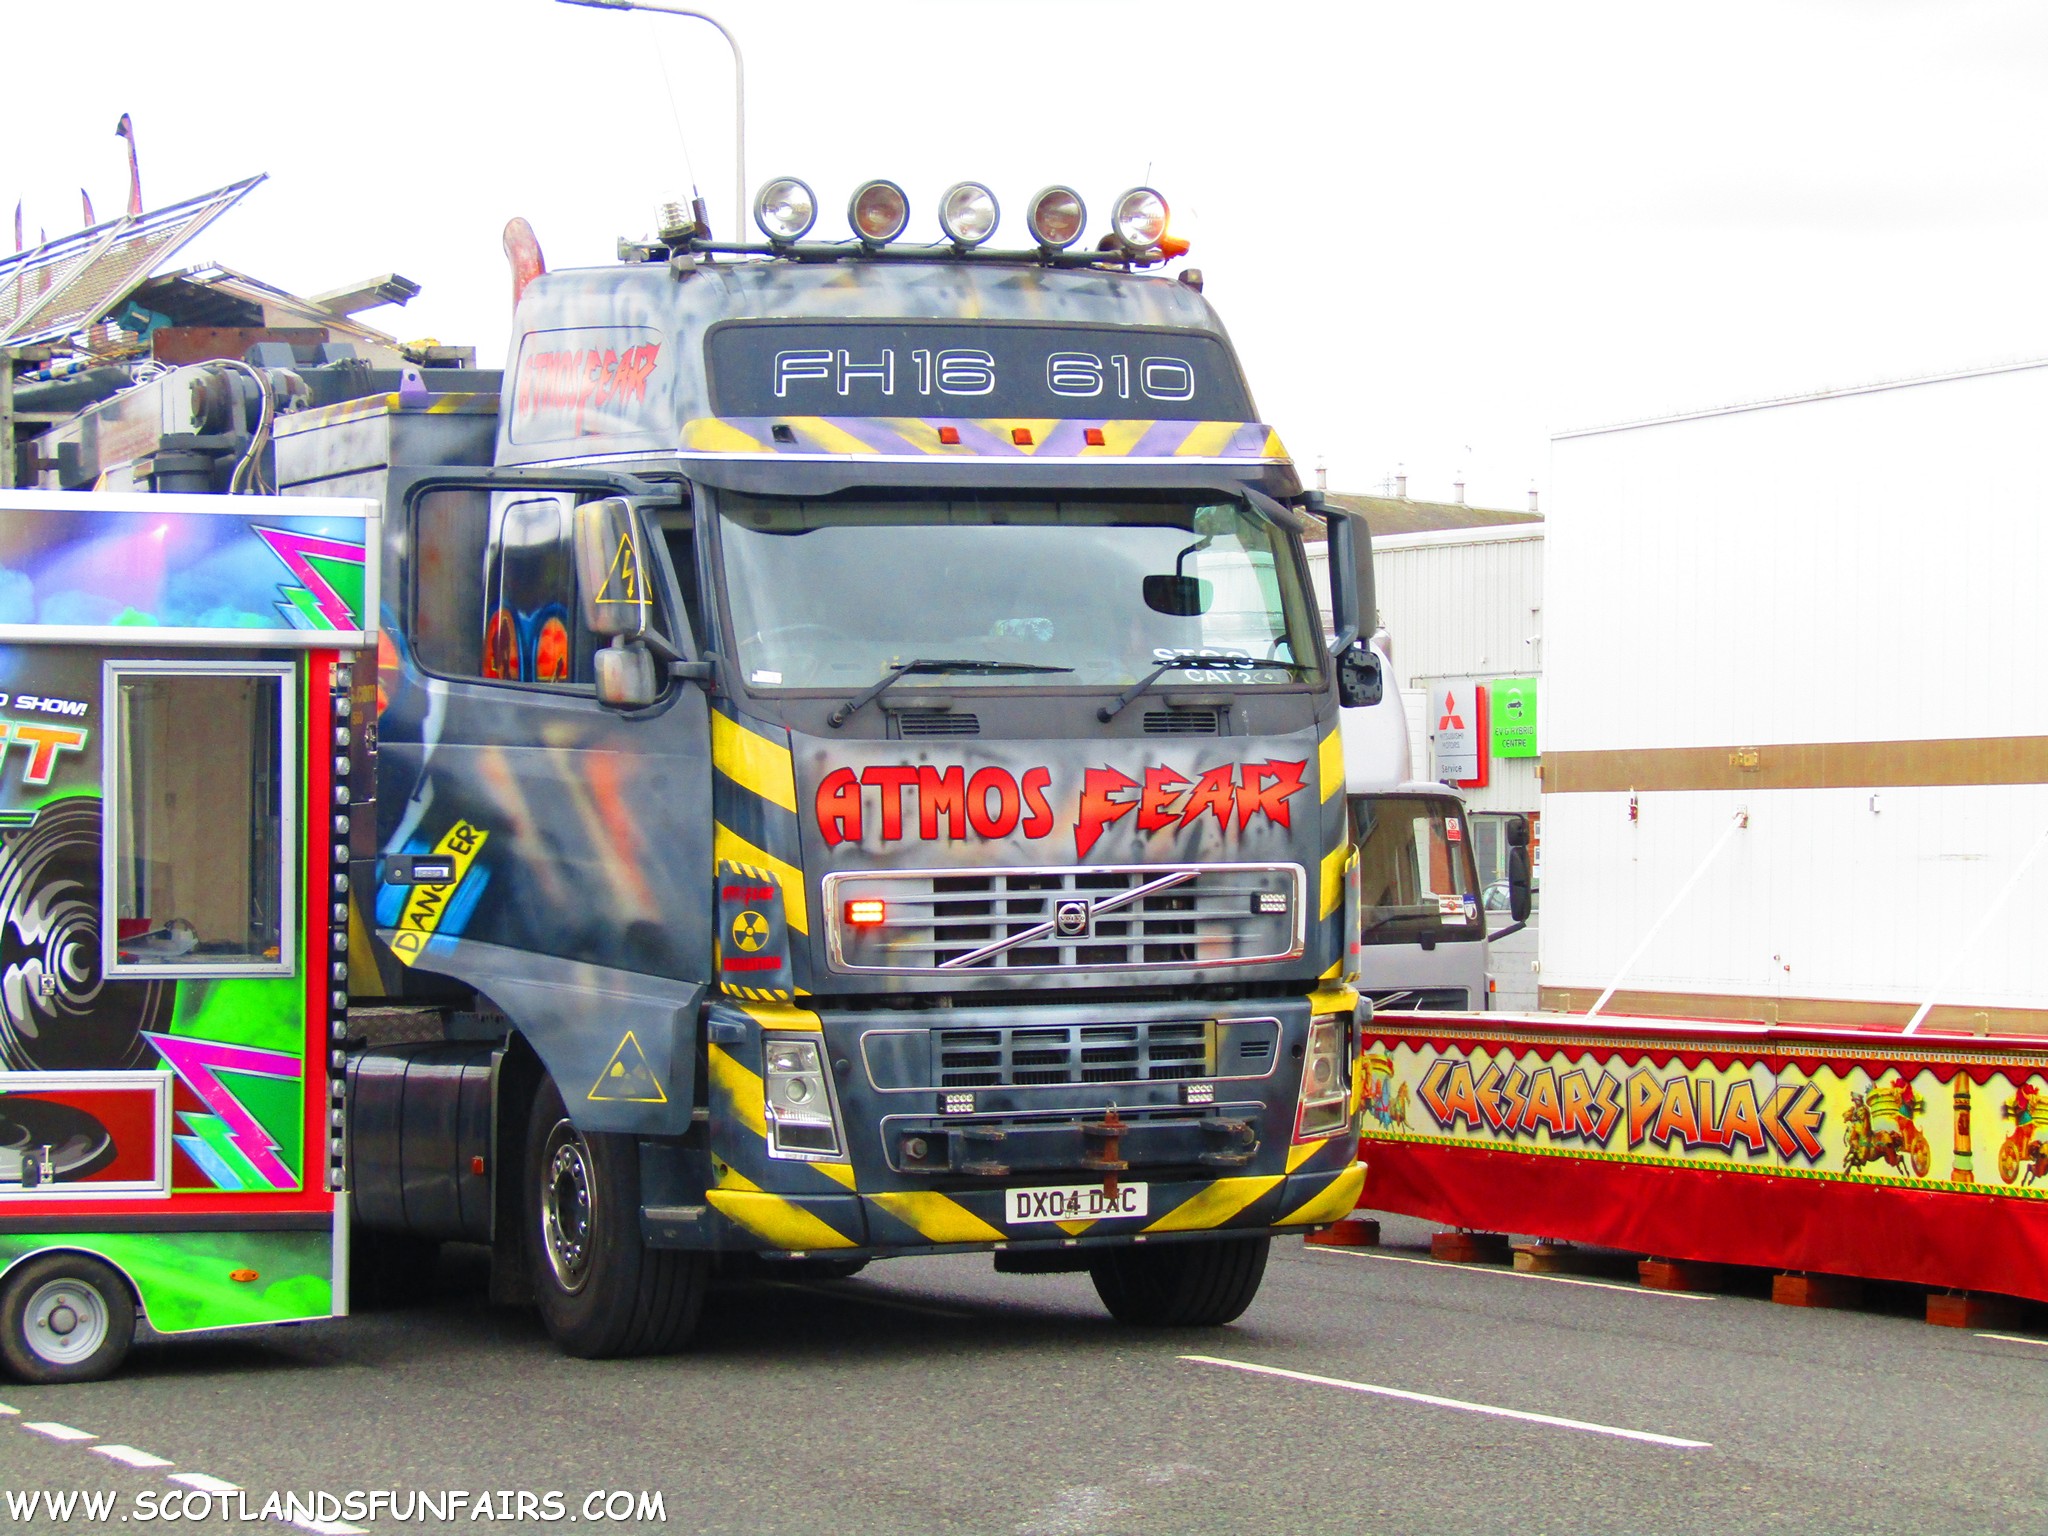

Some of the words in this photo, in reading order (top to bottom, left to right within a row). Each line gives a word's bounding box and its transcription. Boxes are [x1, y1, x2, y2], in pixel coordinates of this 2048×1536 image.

[1046, 351, 1195, 401] 610
[1184, 669, 1234, 683] CAT
[14, 695, 88, 717] SHOW!
[1494, 727, 1503, 736] EV
[1511, 725, 1534, 736] HYBRID
[1501, 738, 1527, 749] CENTRE
[1441, 764, 1463, 774] Service
[815, 764, 1054, 848] ATMOS
[1073, 758, 1310, 860] FEAR
[394, 825, 479, 953] DANER
[1416, 1059, 1622, 1147] CAESARS
[1626, 1065, 1826, 1164] PALACE
[1016, 1190, 1081, 1219] DX04
